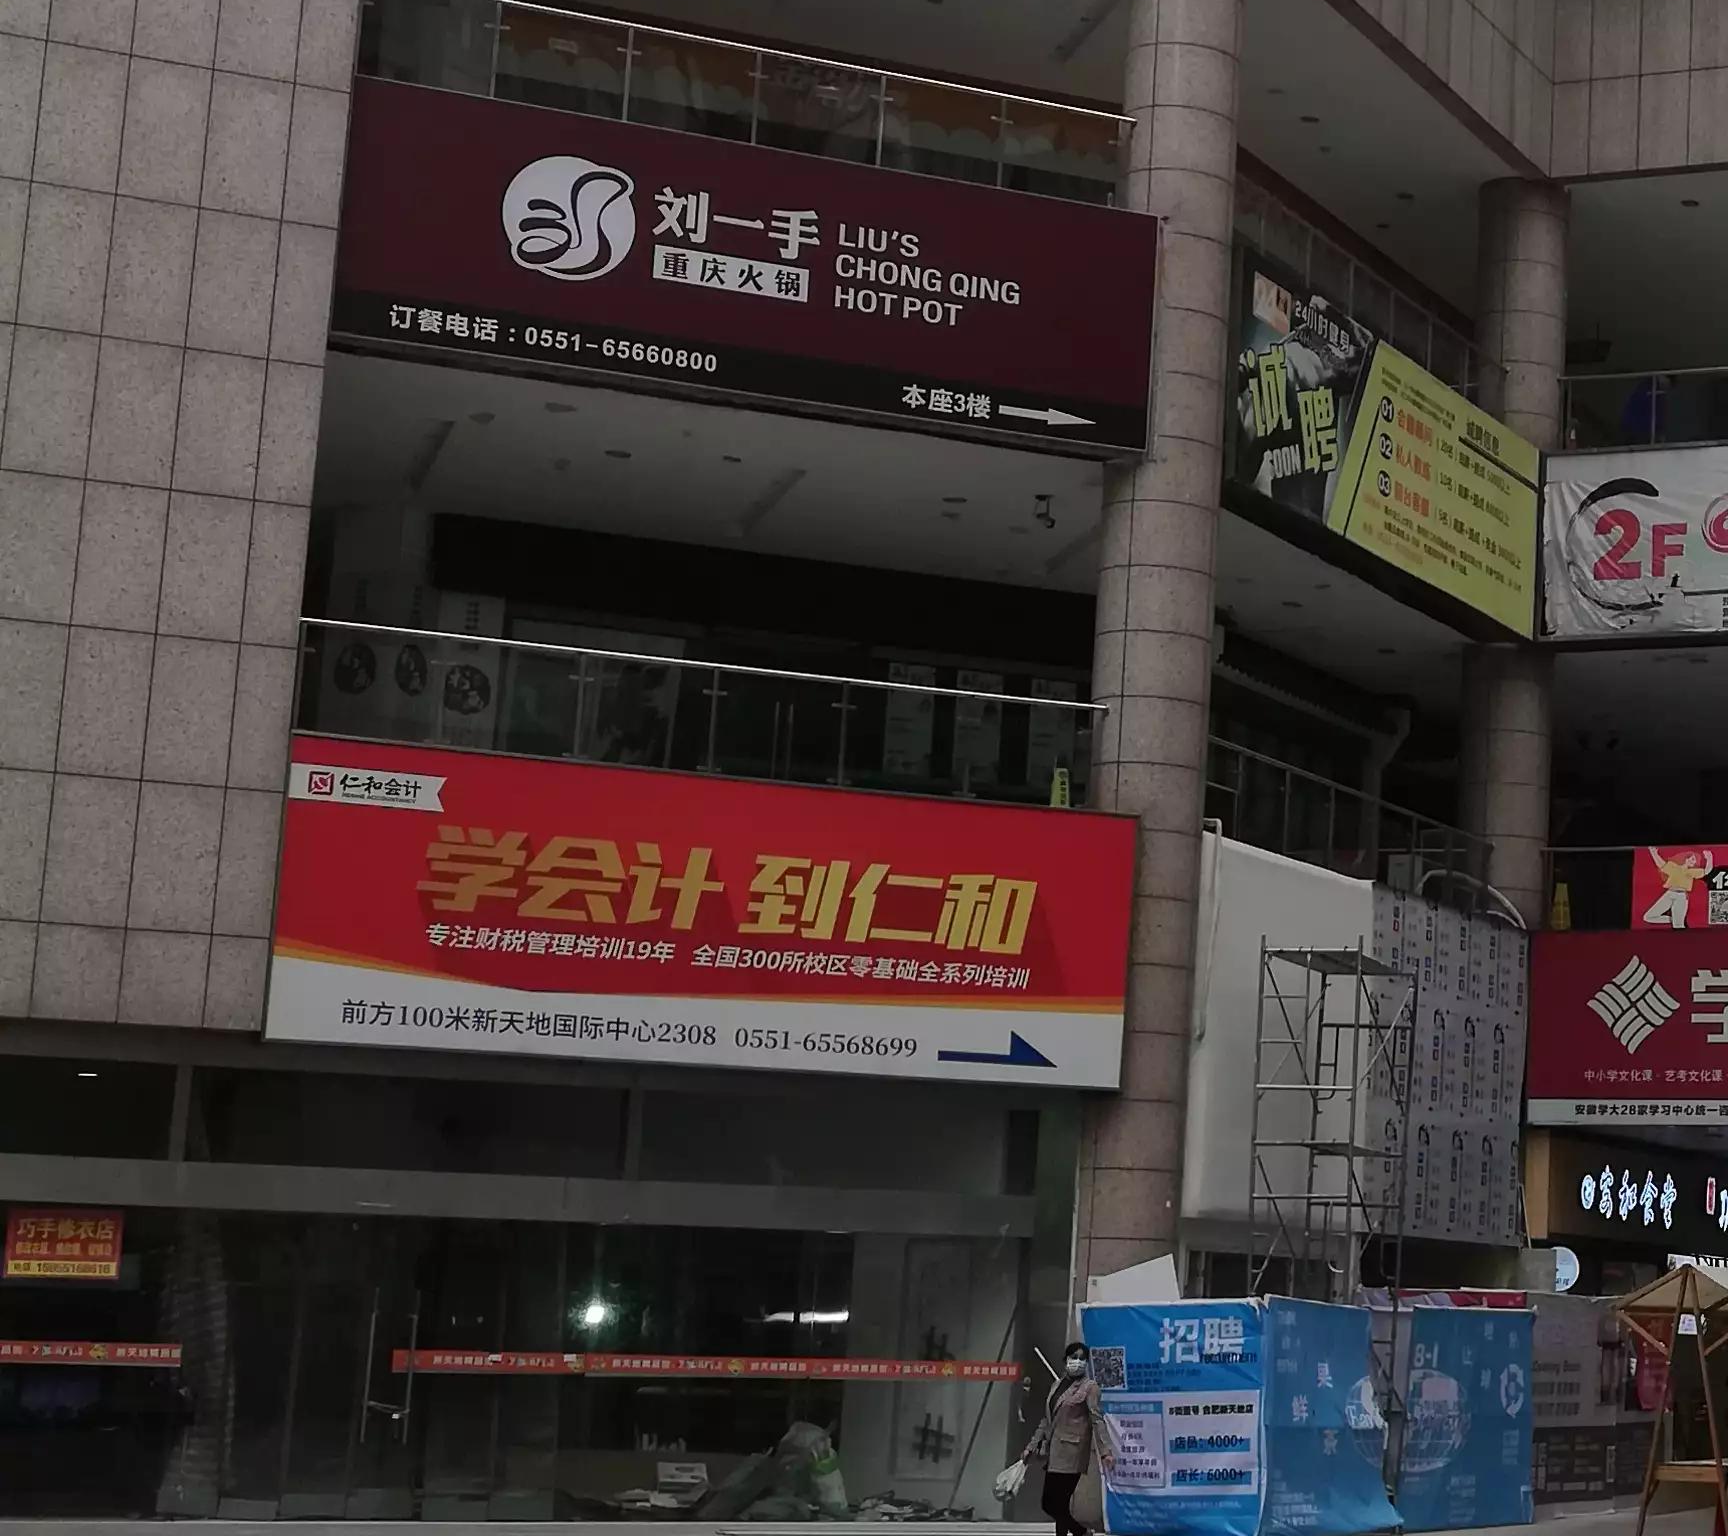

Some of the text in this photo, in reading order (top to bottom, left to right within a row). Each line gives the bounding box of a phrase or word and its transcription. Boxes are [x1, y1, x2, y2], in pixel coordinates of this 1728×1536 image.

[653, 187, 821, 260] 刘一手
[837, 222, 920, 258] LIU'S
[661, 252, 803, 299] 重庆火锅
[836, 254, 1021, 305] CHONG QING
[835, 285, 963, 328] HOT POT
[902, 383, 992, 419] 本座3楼
[1245, 343, 1340, 474] 诚聘
[1380, 399, 1394, 420] 01
[1379, 439, 1393, 458] 02
[1378, 477, 1392, 496] 03
[1593, 508, 1688, 581] 2F
[340, 773, 422, 799] 仁和会计
[416, 824, 1038, 957] 学会计 到仁和
[424, 922, 1031, 990] 专注财税管理培训19年 全国300所校区零基础全系列培训
[341, 996, 919, 1060] 前方100米新天地国际中心2308 0551-65568699
[1583, 1069, 1654, 1084] 中小学文化课
[1664, 1069, 1723, 1084] 艺考文化课
[1158, 1315, 1245, 1364] 招聘
